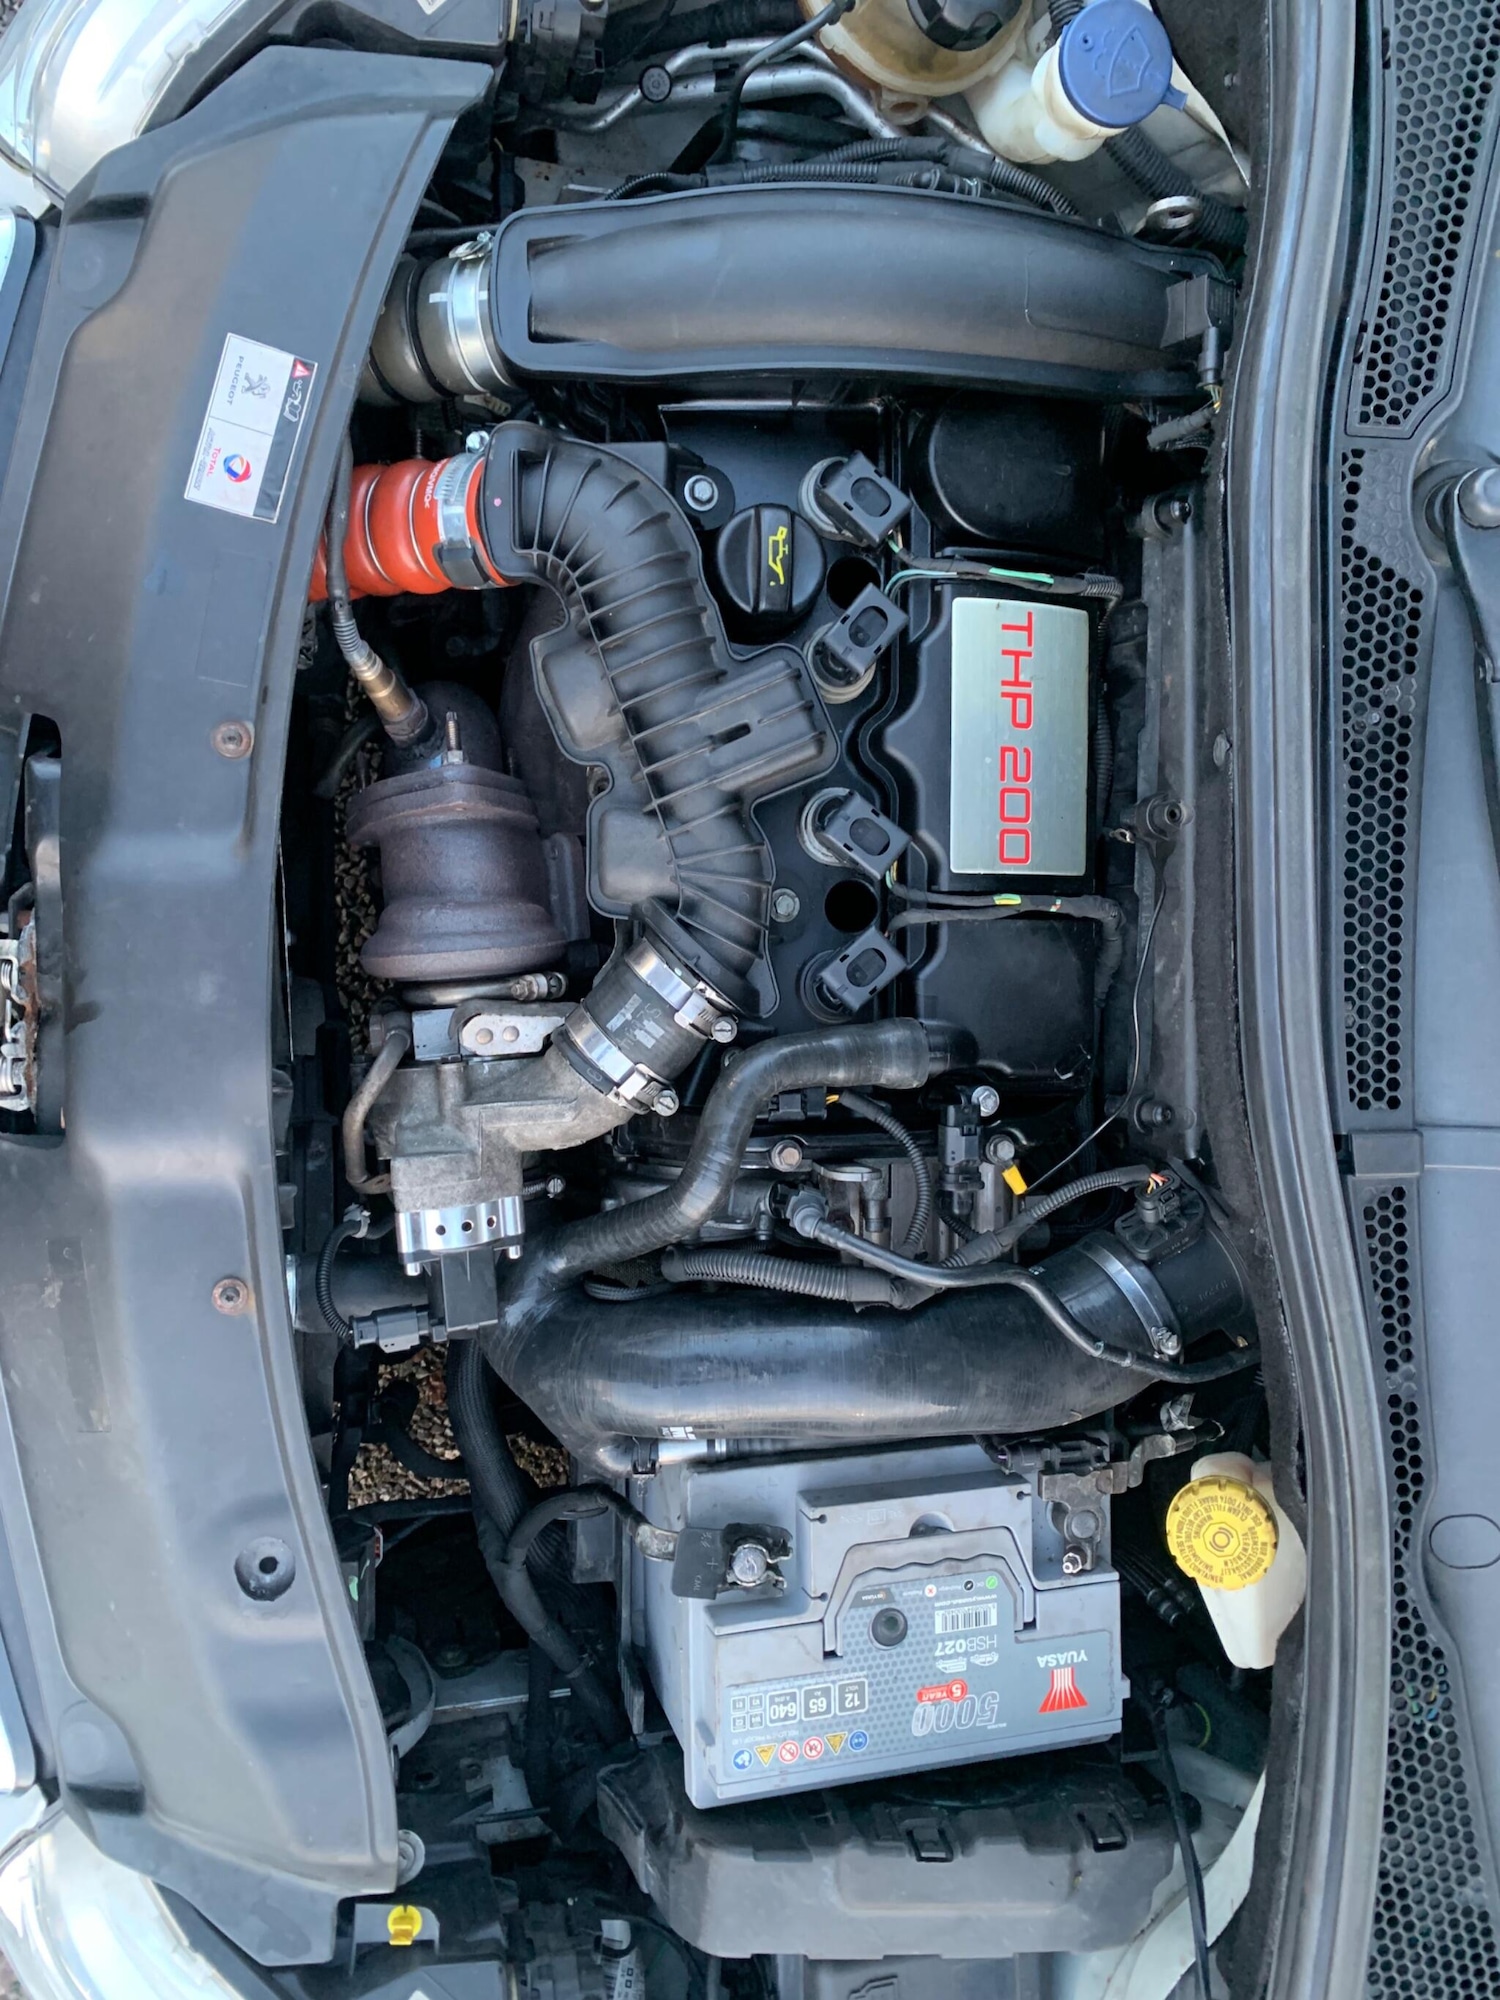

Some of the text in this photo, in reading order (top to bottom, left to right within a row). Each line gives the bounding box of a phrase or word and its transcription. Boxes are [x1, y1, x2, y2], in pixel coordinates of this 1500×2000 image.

[226, 355, 244, 406] PEUGEOT
[206, 447, 222, 477] TOTAL
[999, 611, 1033, 865] THP 200
[1198, 1495, 1219, 1505] BRAKE
[1203, 1504, 1226, 1514] FILLER
[1236, 1501, 1254, 1516] ONLY
[1182, 1501, 1199, 1518] FLUID
[1193, 1510, 1203, 1520] CAP
[1176, 1516, 1187, 1534] FROM
[1250, 1512, 1263, 1527] USE
[1184, 1518, 1193, 1543] BEFORE
[1176, 1540, 1191, 1564] SEALED
[1187, 1543, 1214, 1573] REMOVING
[1223, 1531, 1250, 1568] VERWENDEN
[1239, 1541, 1268, 1581] NUR ORIGINAL
[1189, 1562, 1224, 1584] CONTAINER
[934, 1594, 997, 1607] www.yuasa.com
[934, 1635, 997, 1657] HSB027
[1036, 1649, 1088, 1668] YUASA
[921, 1690, 947, 1701] YEAR
[951, 1683, 962, 1697] 5
[809, 1697, 827, 1714] 65
[844, 1692, 861, 1708] 12
[770, 1702, 797, 1720] 640
[911, 1691, 1000, 1737] 5000
